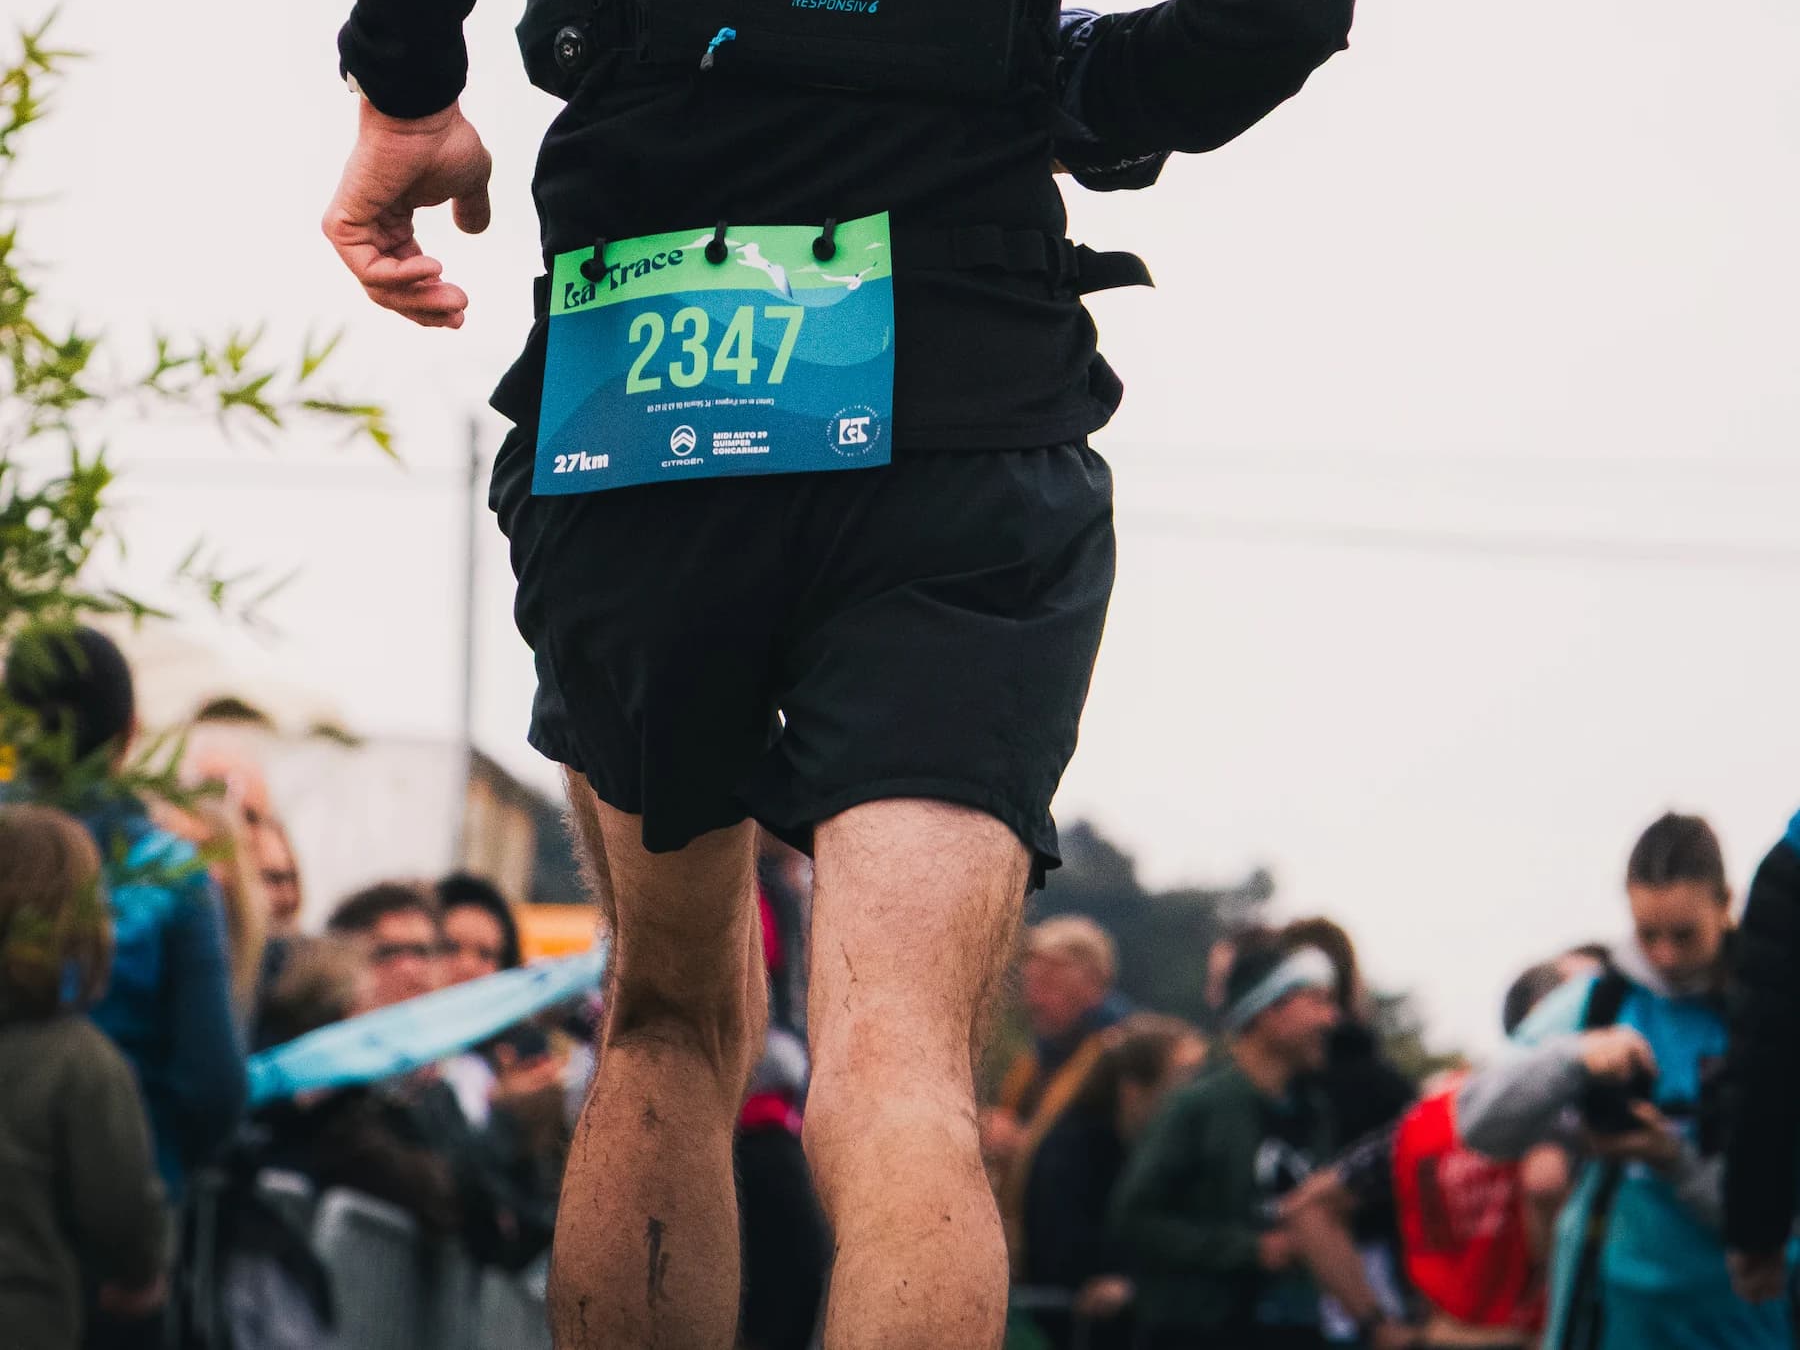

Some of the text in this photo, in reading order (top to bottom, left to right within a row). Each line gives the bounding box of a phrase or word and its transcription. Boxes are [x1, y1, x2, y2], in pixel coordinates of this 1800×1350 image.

[564, 249, 684, 309] La Trace
[625, 306, 805, 395] 2347
[713, 432, 733, 440] MIDI
[733, 432, 756, 440] AUTO
[713, 439, 751, 447] QUIMPER
[712, 446, 770, 456] CONCARNEAU
[553, 451, 609, 474] 27km
